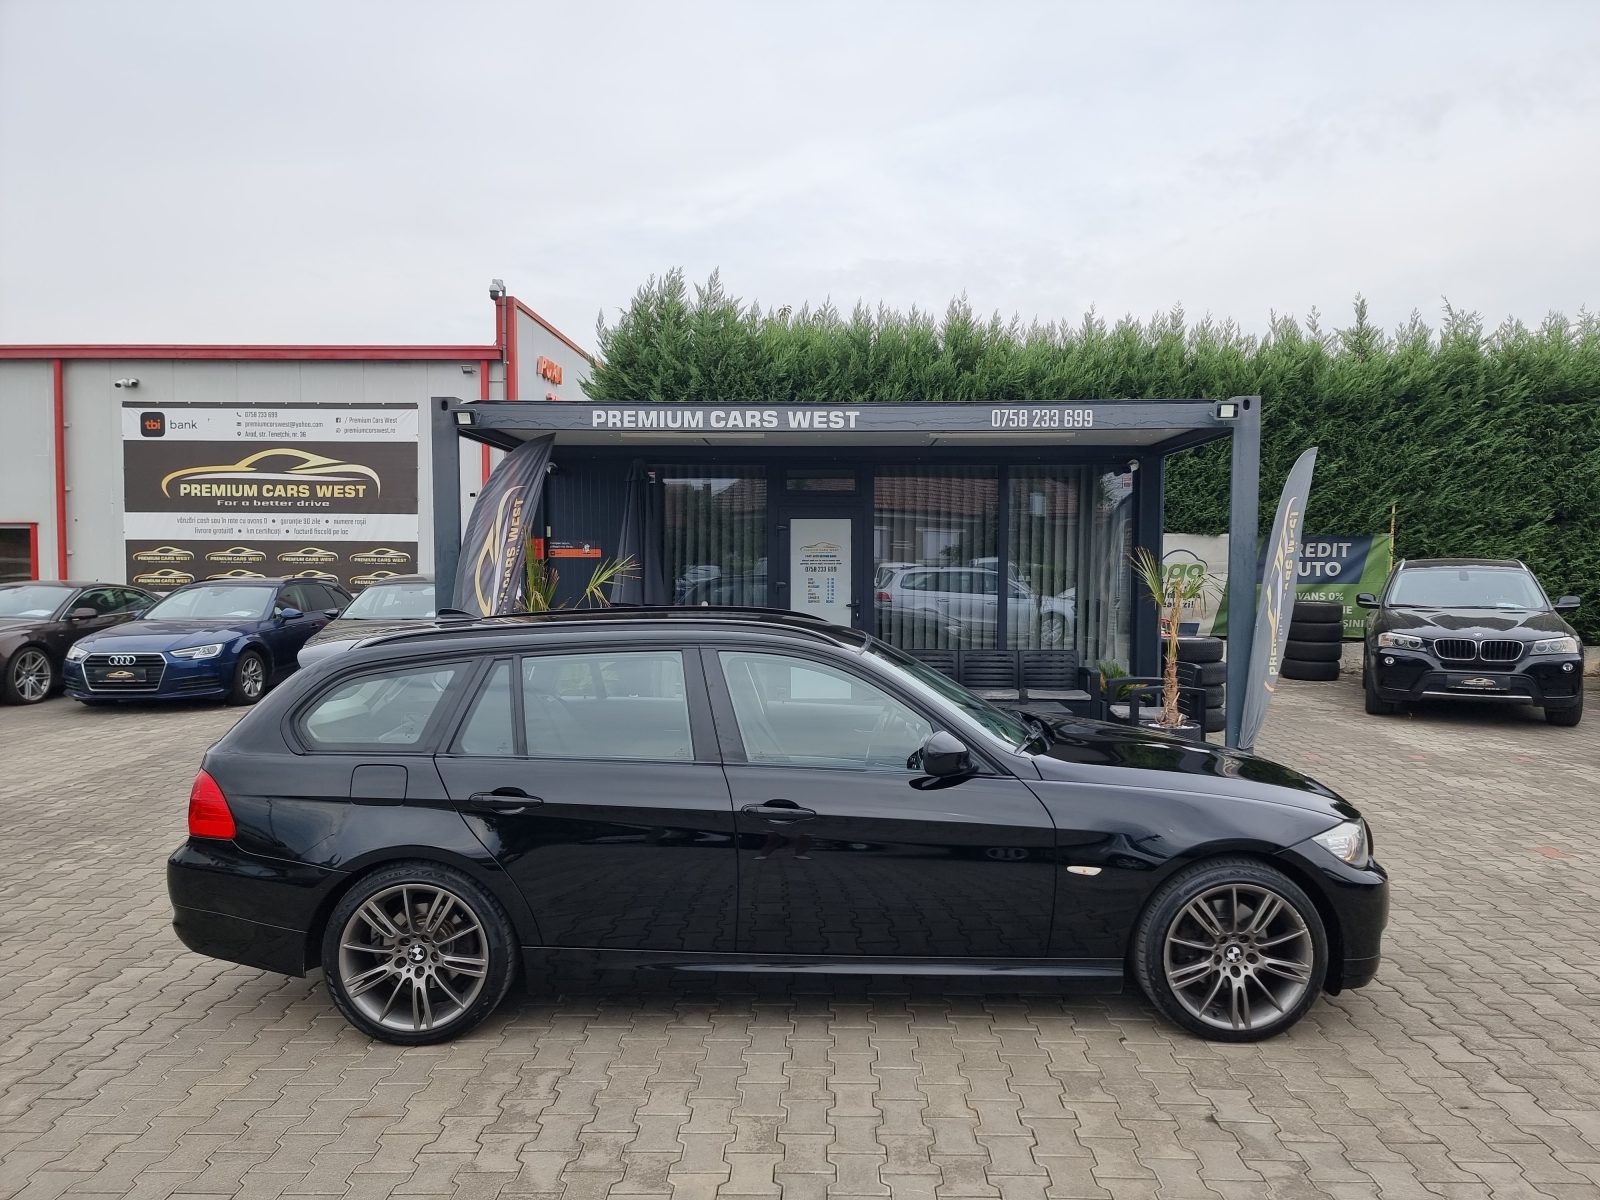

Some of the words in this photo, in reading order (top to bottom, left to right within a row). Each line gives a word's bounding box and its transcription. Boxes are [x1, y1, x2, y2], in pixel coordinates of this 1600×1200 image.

[144, 419, 161, 430] tbi
[169, 419, 198, 430] bank
[592, 410, 704, 428] PREMIUM
[710, 410, 779, 429] CARS
[787, 411, 860, 429] WEST
[991, 409, 1028, 427] 0758
[1032, 409, 1059, 427] 233
[1064, 409, 1093, 427] 699
[179, 484, 258, 498] PREMIUM
[262, 484, 310, 498] CARS
[315, 485, 367, 498] WEST
[507, 498, 524, 542] WEST
[1299, 542, 1352, 558] REDIT
[1298, 561, 1341, 577] UTO
[1296, 592, 1325, 600] VANS
[1328, 592, 1344, 600] 0%
